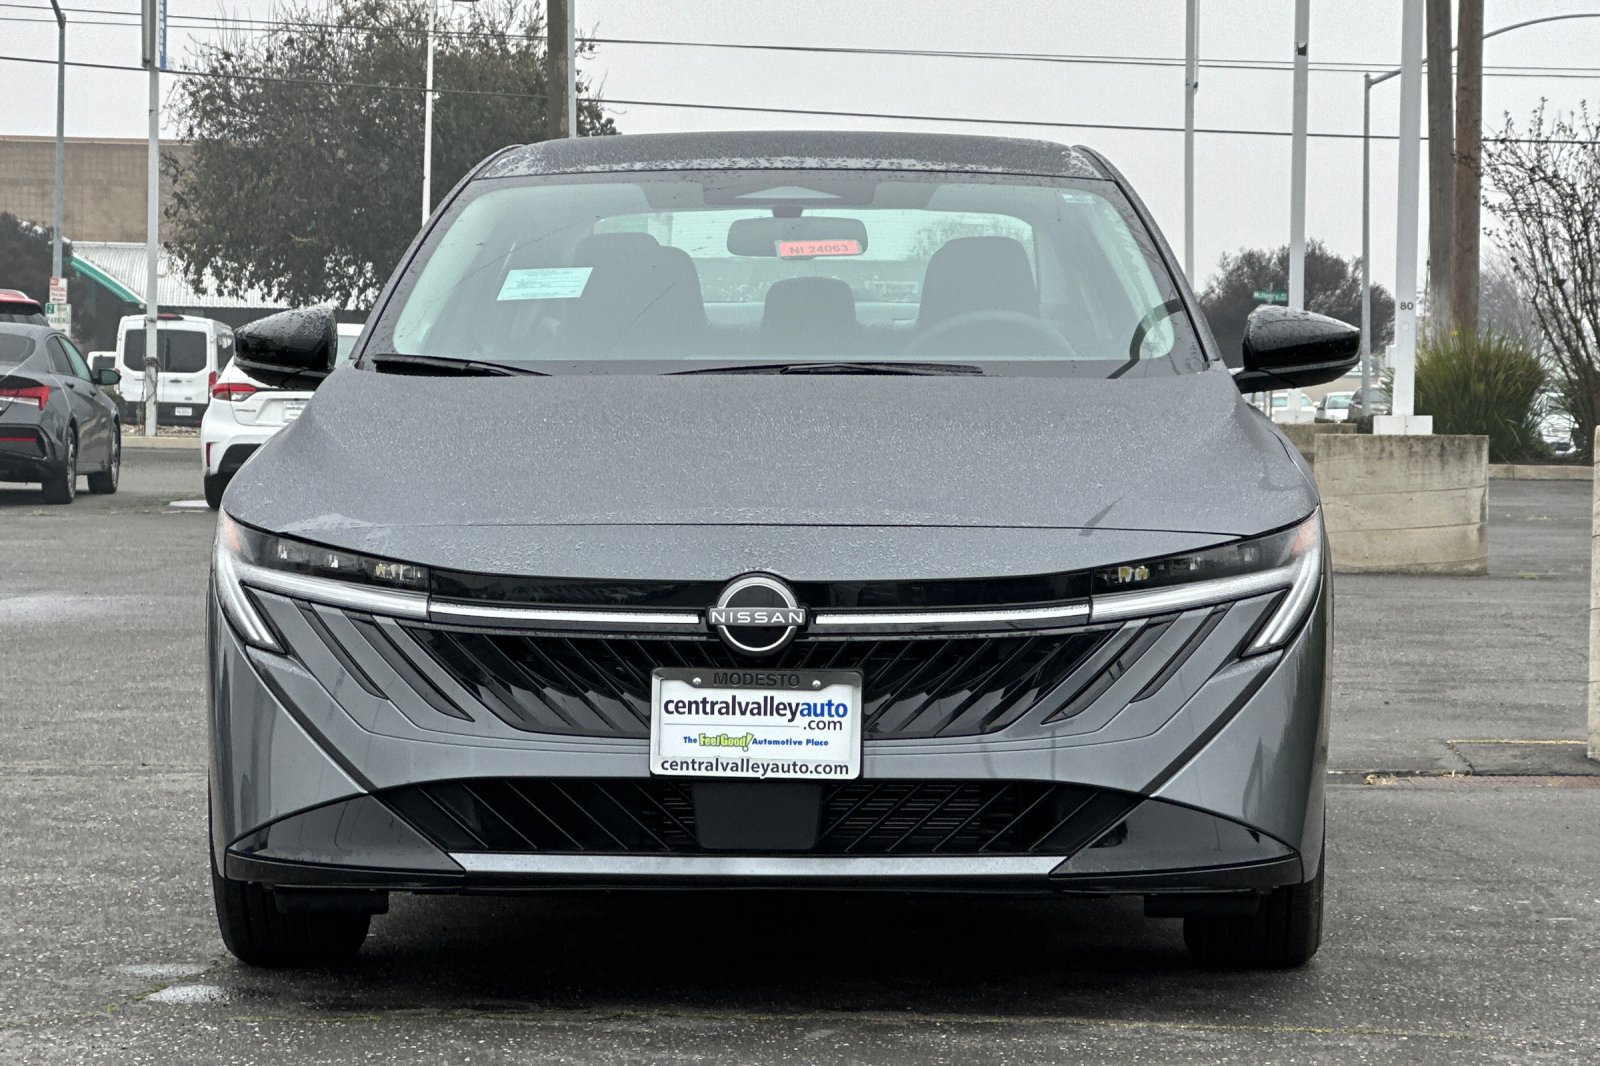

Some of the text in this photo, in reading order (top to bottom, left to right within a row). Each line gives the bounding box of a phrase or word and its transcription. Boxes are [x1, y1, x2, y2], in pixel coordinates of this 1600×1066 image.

[789, 244, 849, 254] NI 24063
[48, 305, 53, 313] 2
[1400, 301, 1414, 311] 80
[711, 611, 803, 624] NISSAN
[713, 672, 801, 688] MODESTO
[663, 695, 849, 722] centralvalleyauto
[803, 720, 843, 731] .com
[683, 736, 698, 744] The
[752, 738, 803, 746] Automotive
[806, 738, 829, 746] Place
[661, 757, 849, 777] centralvalleyauto.com
